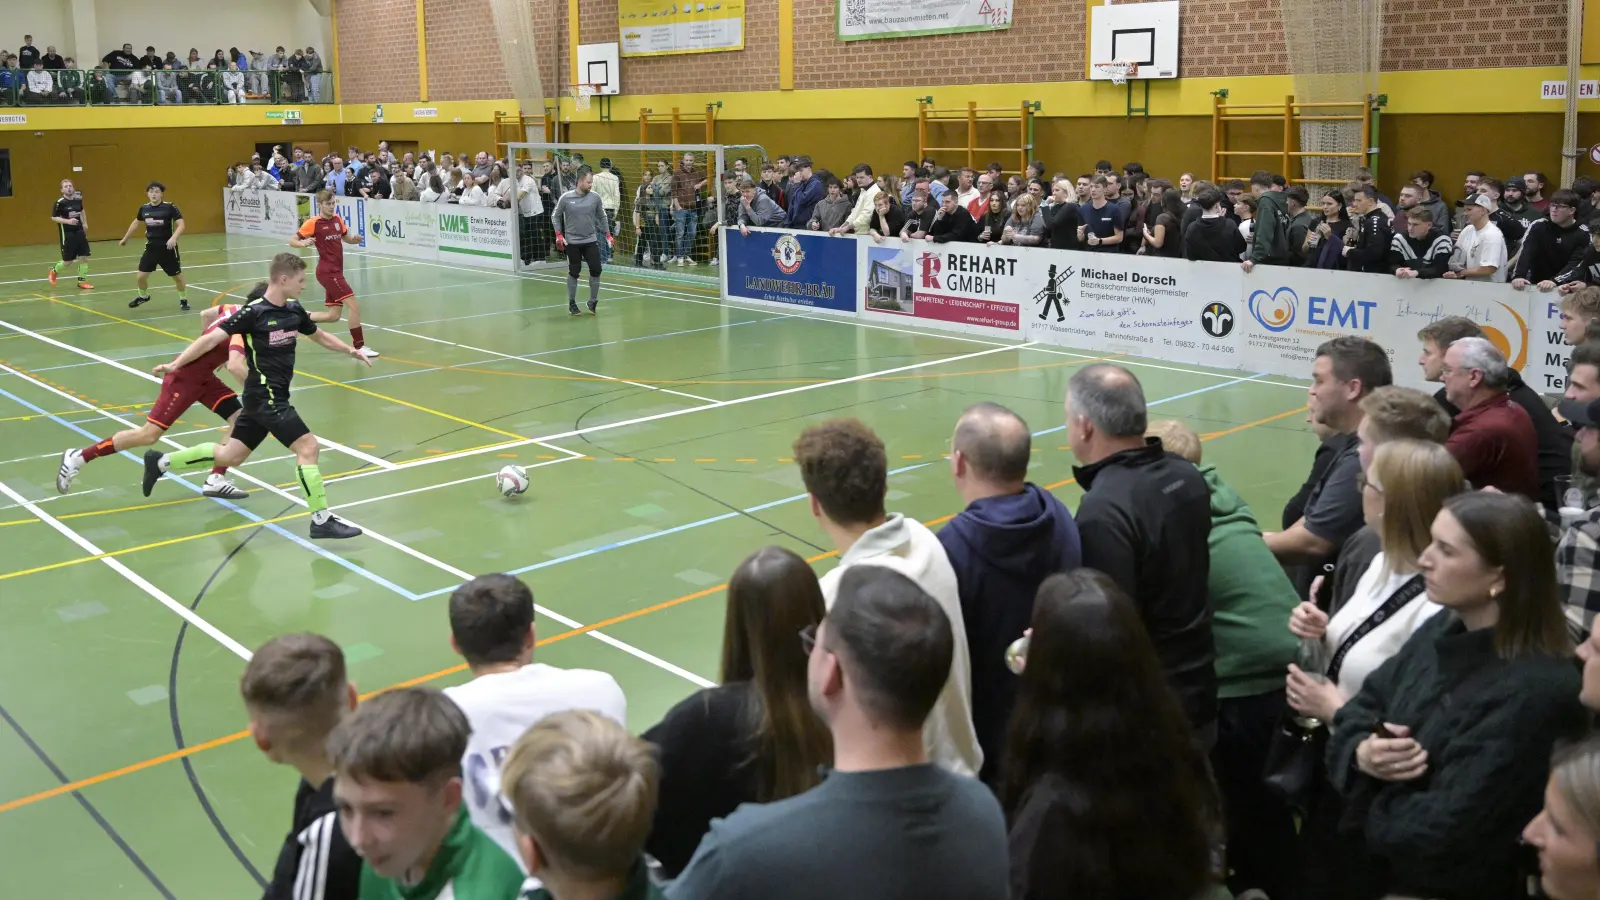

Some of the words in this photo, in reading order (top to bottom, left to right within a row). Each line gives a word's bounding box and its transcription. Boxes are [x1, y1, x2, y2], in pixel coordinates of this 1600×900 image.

[868, 12, 949, 25] www.bauzaun-mieten.net
[1543, 84, 1594, 96] RAUEN
[384, 219, 406, 239] S&L
[439, 213, 460, 233] LVM
[470, 216, 484, 225] Erwin
[947, 253, 1018, 276] REHART
[946, 273, 996, 295] GMBH
[1081, 267, 1128, 282] Michael
[1131, 272, 1176, 286] Dorsch
[745, 276, 836, 299] LANDWEHR-BRÄU
[1080, 280, 1189, 298] Bezirksschornsteinfegermeister
[915, 295, 945, 305] KOMPETENZ
[948, 300, 986, 310] LEIDENSCHAFT
[990, 304, 1017, 313] EFFIZIENZ
[1080, 290, 1130, 302] Energieberater
[1131, 295, 1156, 306] (HWK)
[966, 315, 1017, 327] www.rehart-group.de
[1307, 296, 1377, 330] EMT
[1118, 320, 1131, 329] den
[1133, 317, 1193, 329] Schornsteinfeger
[1031, 322, 1048, 331] 91717
[1049, 324, 1096, 337] Wassertrüdingen
[1104, 331, 1148, 343] Bahnhofstraße
[1149, 336, 1154, 344] 8
[1175, 339, 1196, 349] 09832
[1201, 343, 1210, 351] 70
[1211, 344, 1220, 352] 44
[1221, 345, 1235, 354] 506
[1248, 340, 1266, 348] 91717
[1267, 342, 1315, 354] Wassertrüdingen
[1258, 333, 1291, 343] Krautgarten
